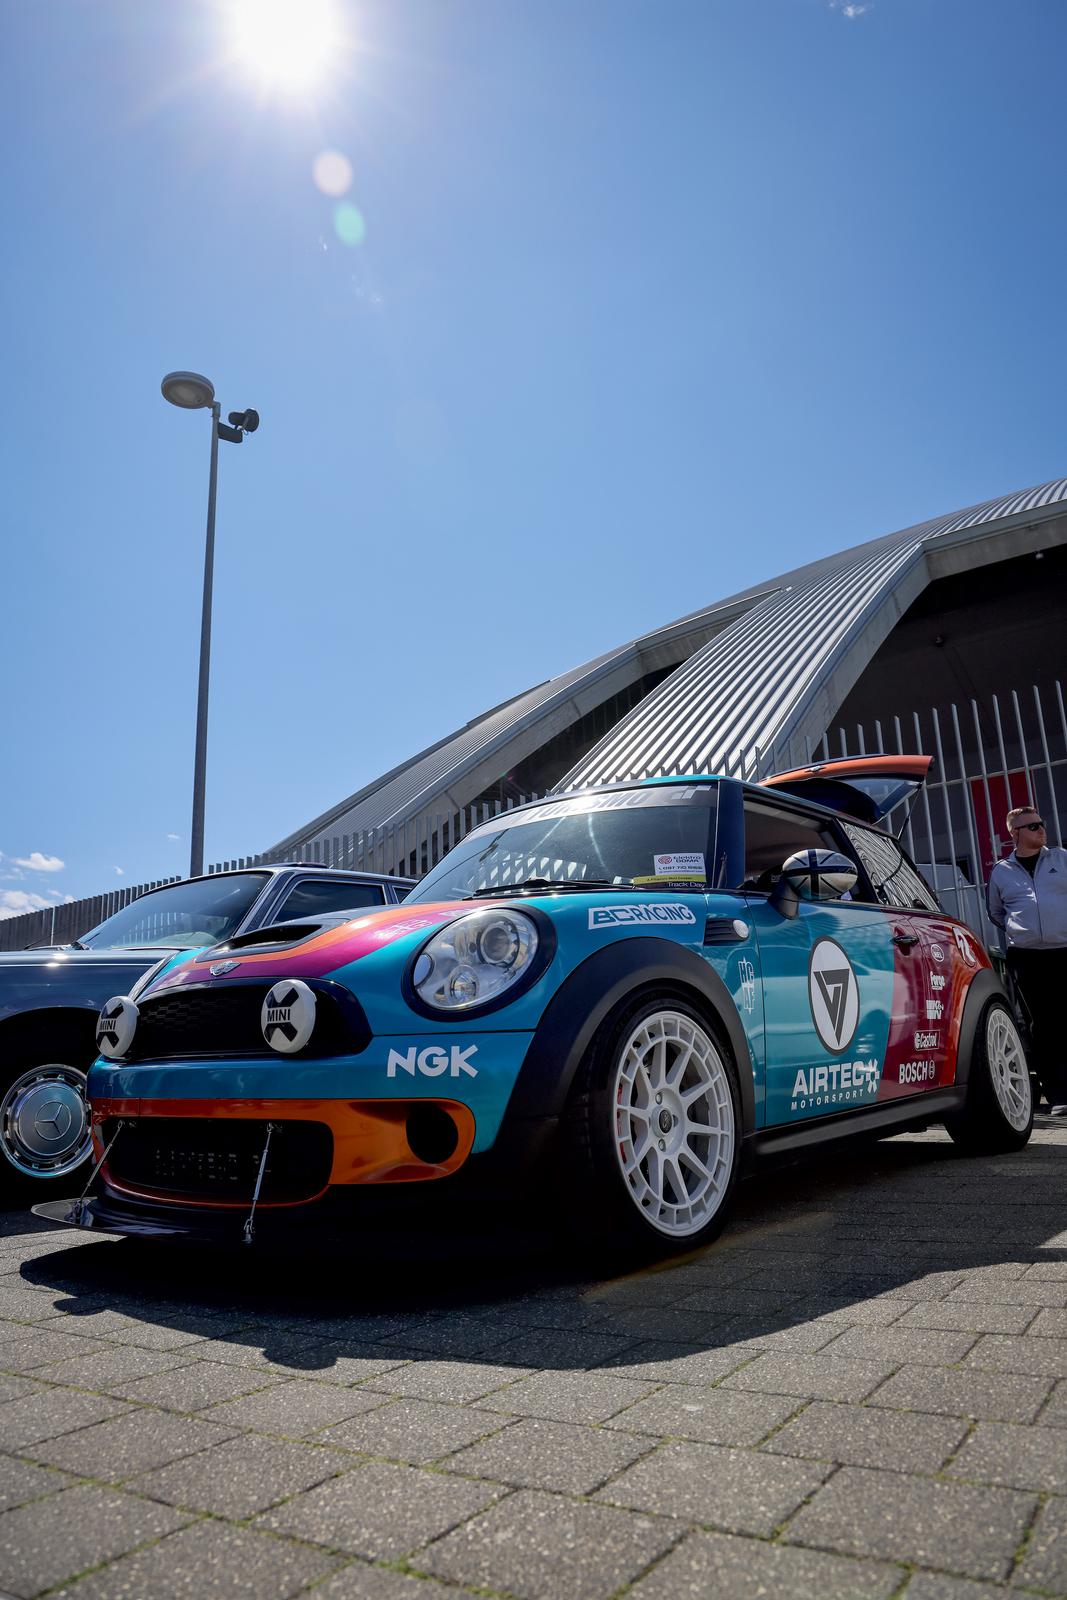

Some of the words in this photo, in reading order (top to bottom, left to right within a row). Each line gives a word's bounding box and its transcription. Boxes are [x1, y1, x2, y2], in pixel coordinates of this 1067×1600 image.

[689, 882, 706, 890] Day
[267, 1008, 291, 1022] MINI
[99, 1018, 116, 1031] MINI
[920, 1032, 938, 1049] Castrol
[387, 1044, 479, 1078] NGK
[899, 1061, 928, 1084] BOSCH
[790, 1088, 864, 1111] MOTORSPORT
